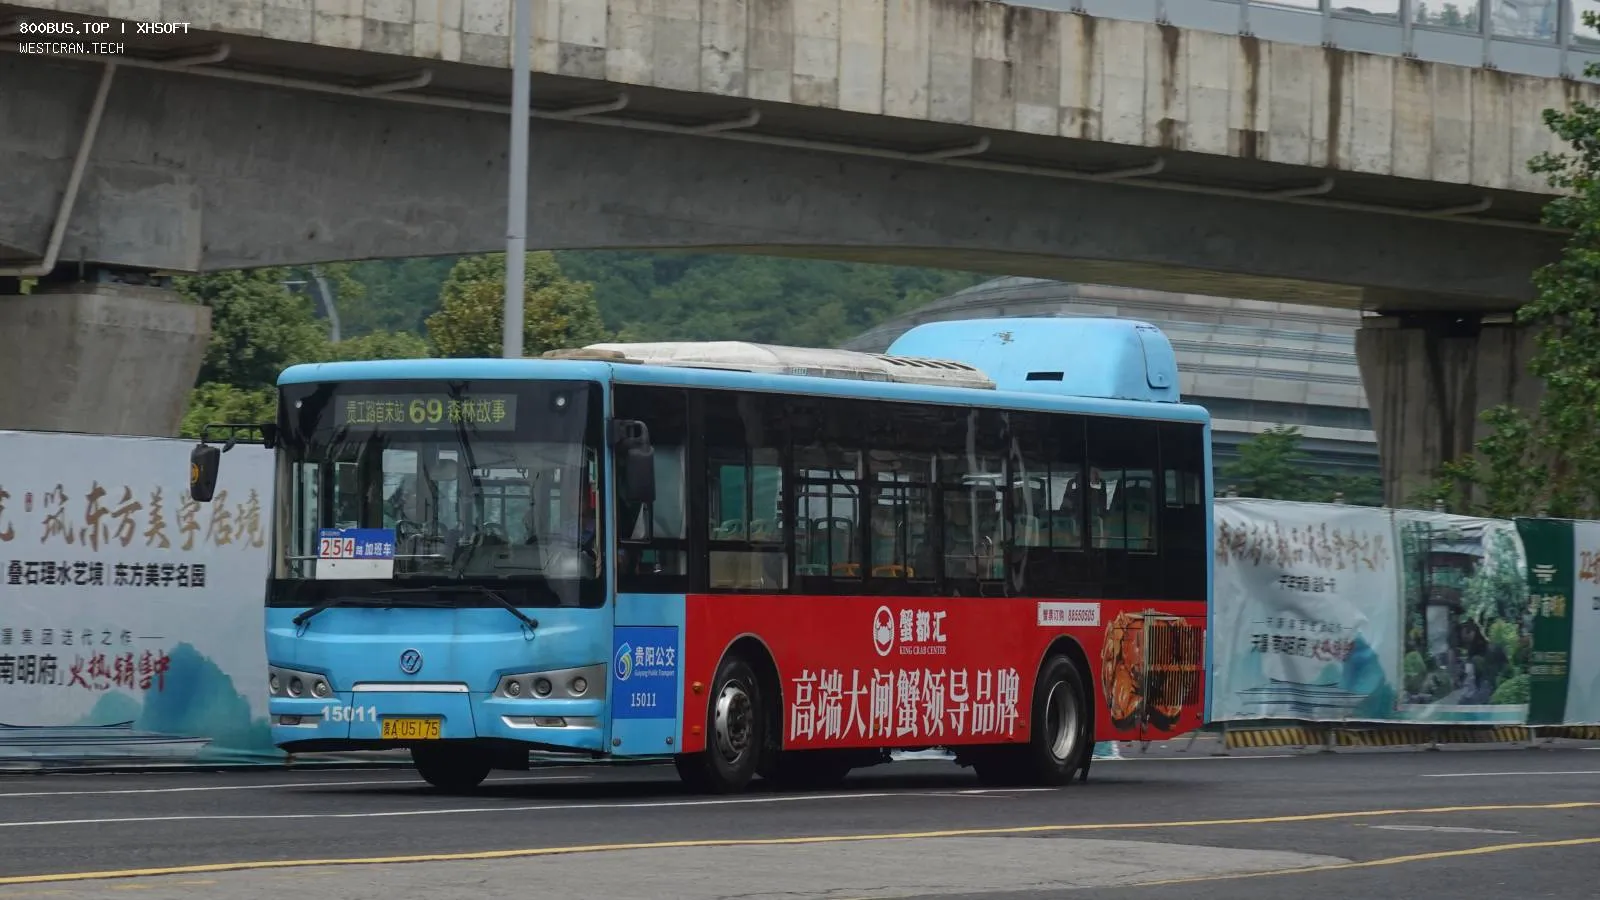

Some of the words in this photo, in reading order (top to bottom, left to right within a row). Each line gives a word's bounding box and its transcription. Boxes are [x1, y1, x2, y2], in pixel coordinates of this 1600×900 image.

[409, 399, 443, 423] 69
[447, 399, 506, 423] 森林故事
[321, 539, 353, 556] 254
[365, 541, 392, 556] 加班车
[8, 560, 104, 587] 叠石理水艺境
[113, 562, 206, 588] 东方美学名园
[899, 608, 947, 642] 蟹都汇
[635, 646, 675, 667] 贵阳公交
[631, 692, 657, 707] 15011
[790, 668, 1020, 741] 高端大闸蟹领导品牌
[321, 705, 377, 722] 15011
